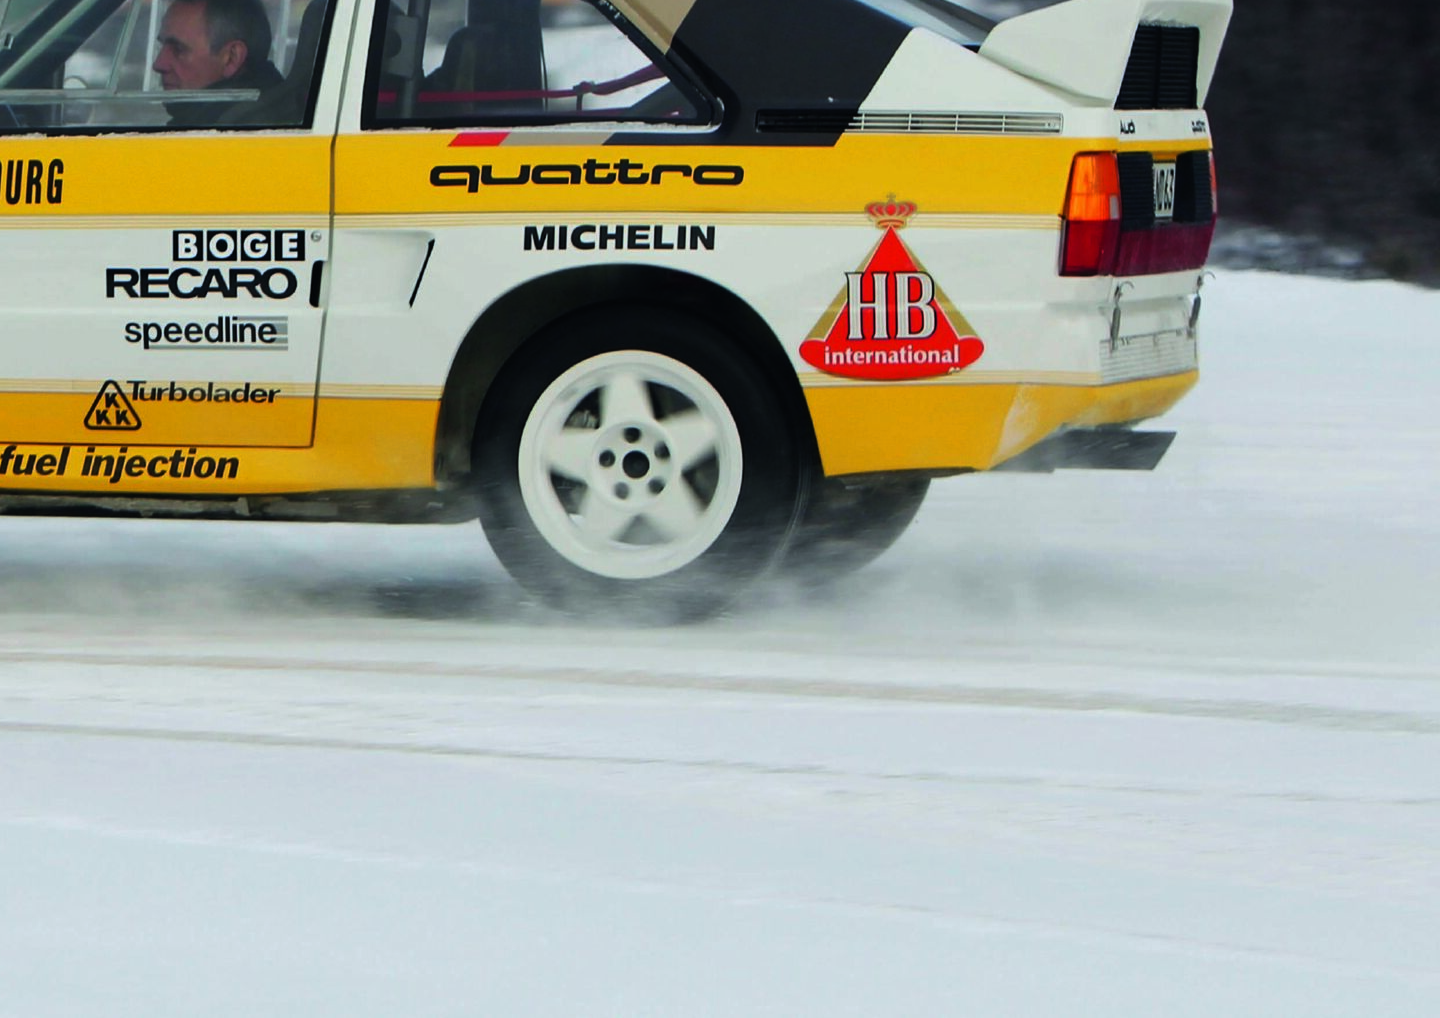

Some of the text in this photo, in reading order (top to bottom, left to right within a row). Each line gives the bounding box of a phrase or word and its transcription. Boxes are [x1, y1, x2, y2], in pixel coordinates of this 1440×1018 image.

[429, 158, 744, 193] quattro
[172, 229, 306, 261] BOGE
[523, 225, 716, 250] MICHELIN
[105, 267, 298, 300] RECARO
[844, 271, 938, 341] HB
[124, 316, 278, 350] speedline
[824, 344, 960, 366] international
[126, 380, 281, 403] Turbolader
[81, 447, 240, 484] injection
